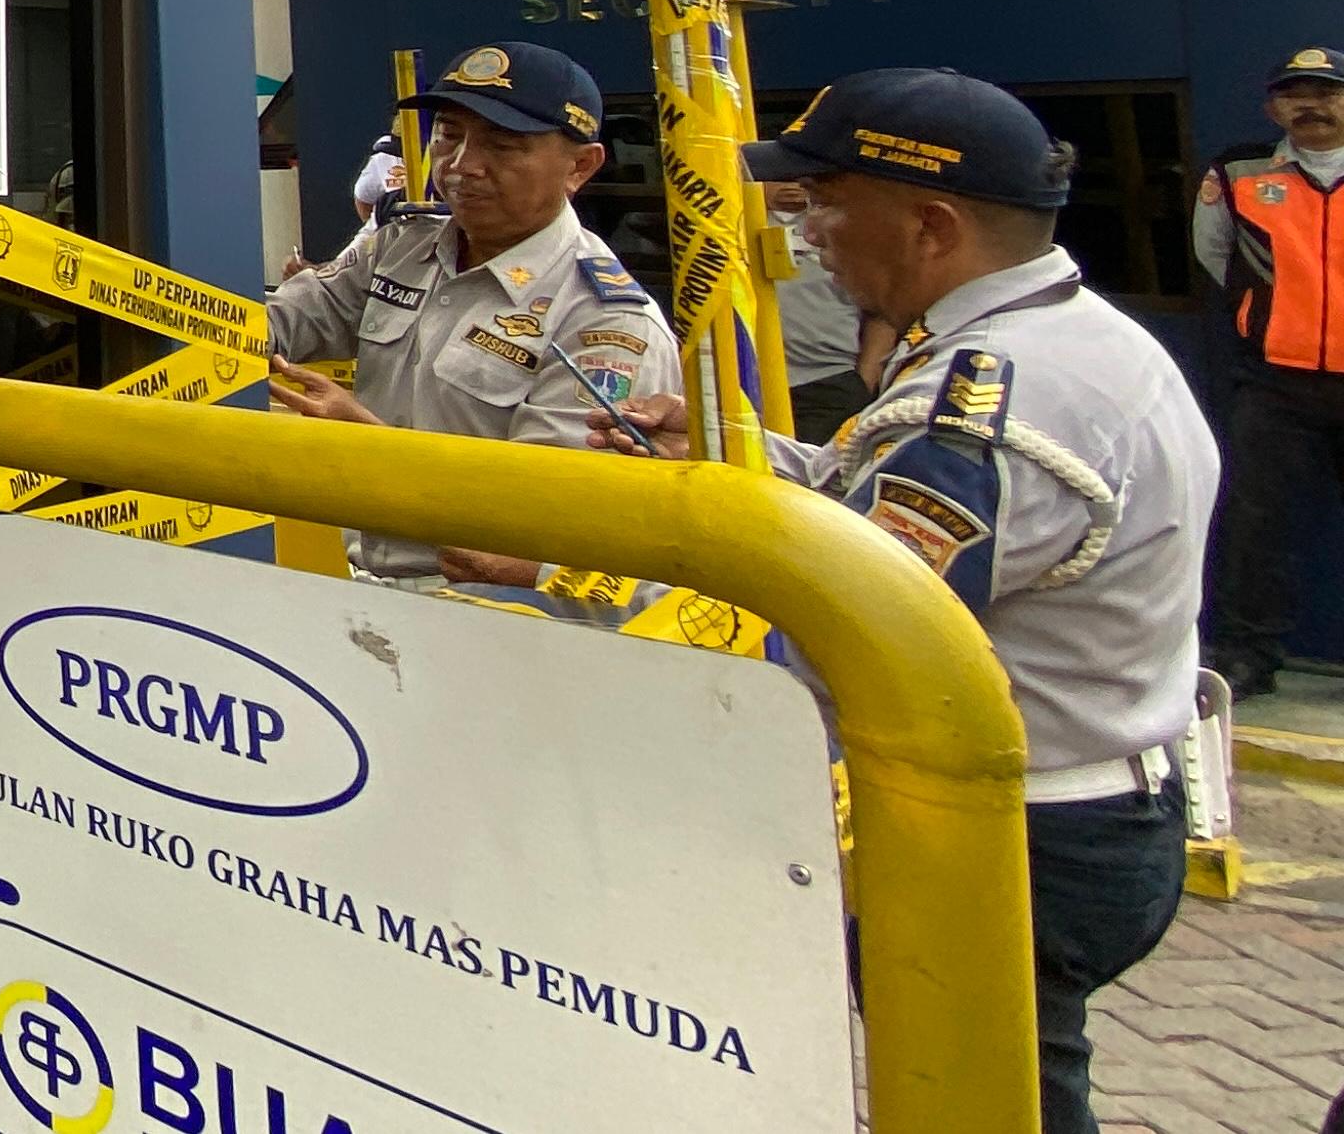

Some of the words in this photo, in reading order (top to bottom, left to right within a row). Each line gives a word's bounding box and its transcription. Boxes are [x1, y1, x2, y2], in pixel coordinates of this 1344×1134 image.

[89, 279, 118, 308] DINAS
[118, 290, 187, 333] PERHUBUNGAN
[186, 314, 226, 346] PROVINSI
[227, 328, 242, 352] DKI
[133, 267, 153, 291] UP
[156, 276, 248, 328] PERPARKIRAN
[473, 331, 529, 365] DISHUB
[56, 648, 286, 765] PRGMP
[85, 802, 196, 870] RUKO
[207, 849, 365, 934] GRAHA
[375, 904, 485, 976] MAS
[497, 947, 756, 1075] PEMUDA
